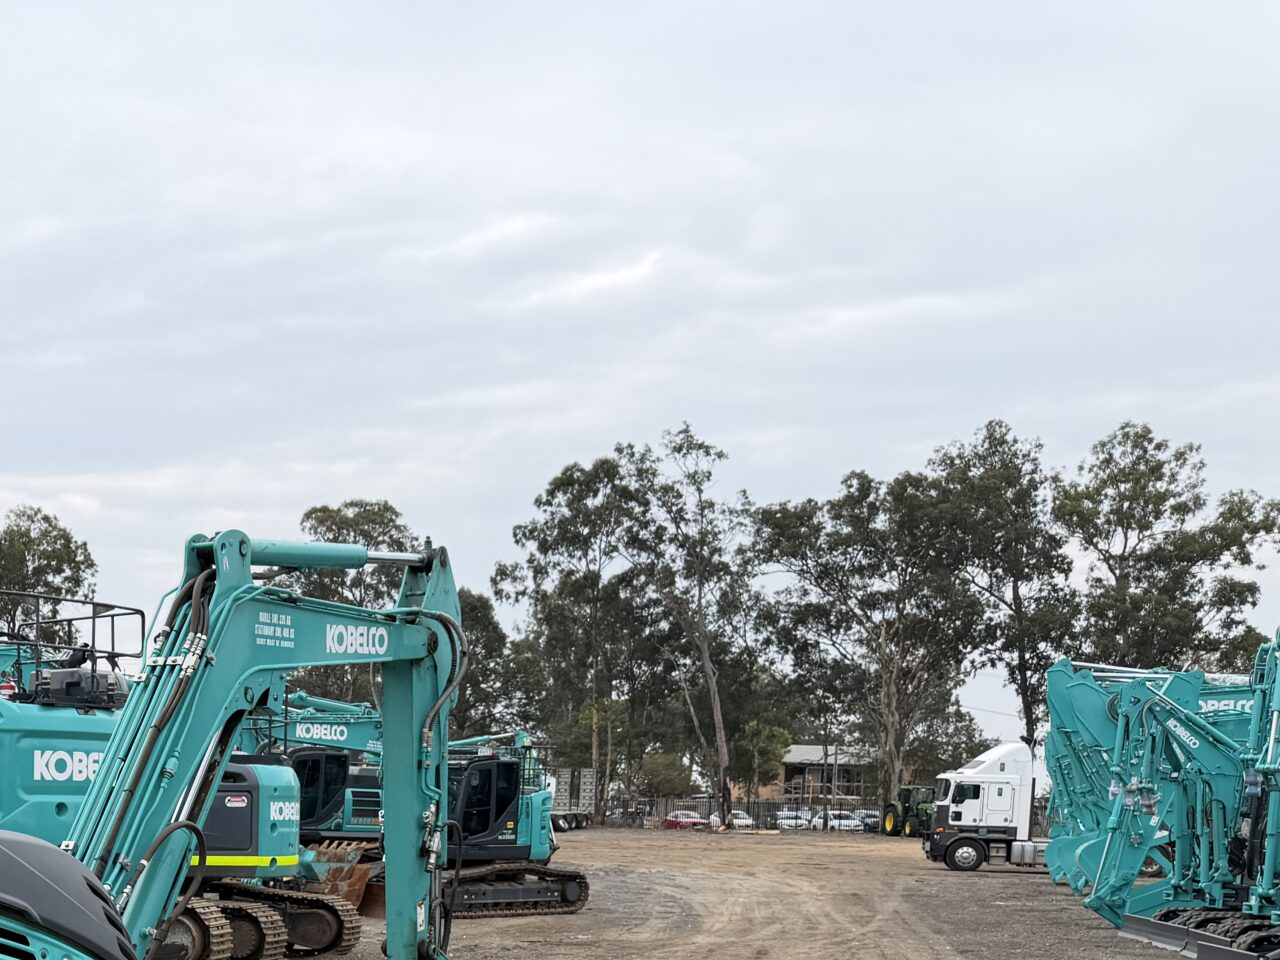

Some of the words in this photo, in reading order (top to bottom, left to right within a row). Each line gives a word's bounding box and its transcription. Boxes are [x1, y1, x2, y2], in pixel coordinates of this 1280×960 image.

[326, 624, 388, 655] KOBELCO
[1198, 699, 1255, 713] OBELCO
[296, 722, 348, 741] KOBELCO
[1166, 718, 1200, 749] KOBELCO
[34, 750, 105, 781] KOBE
